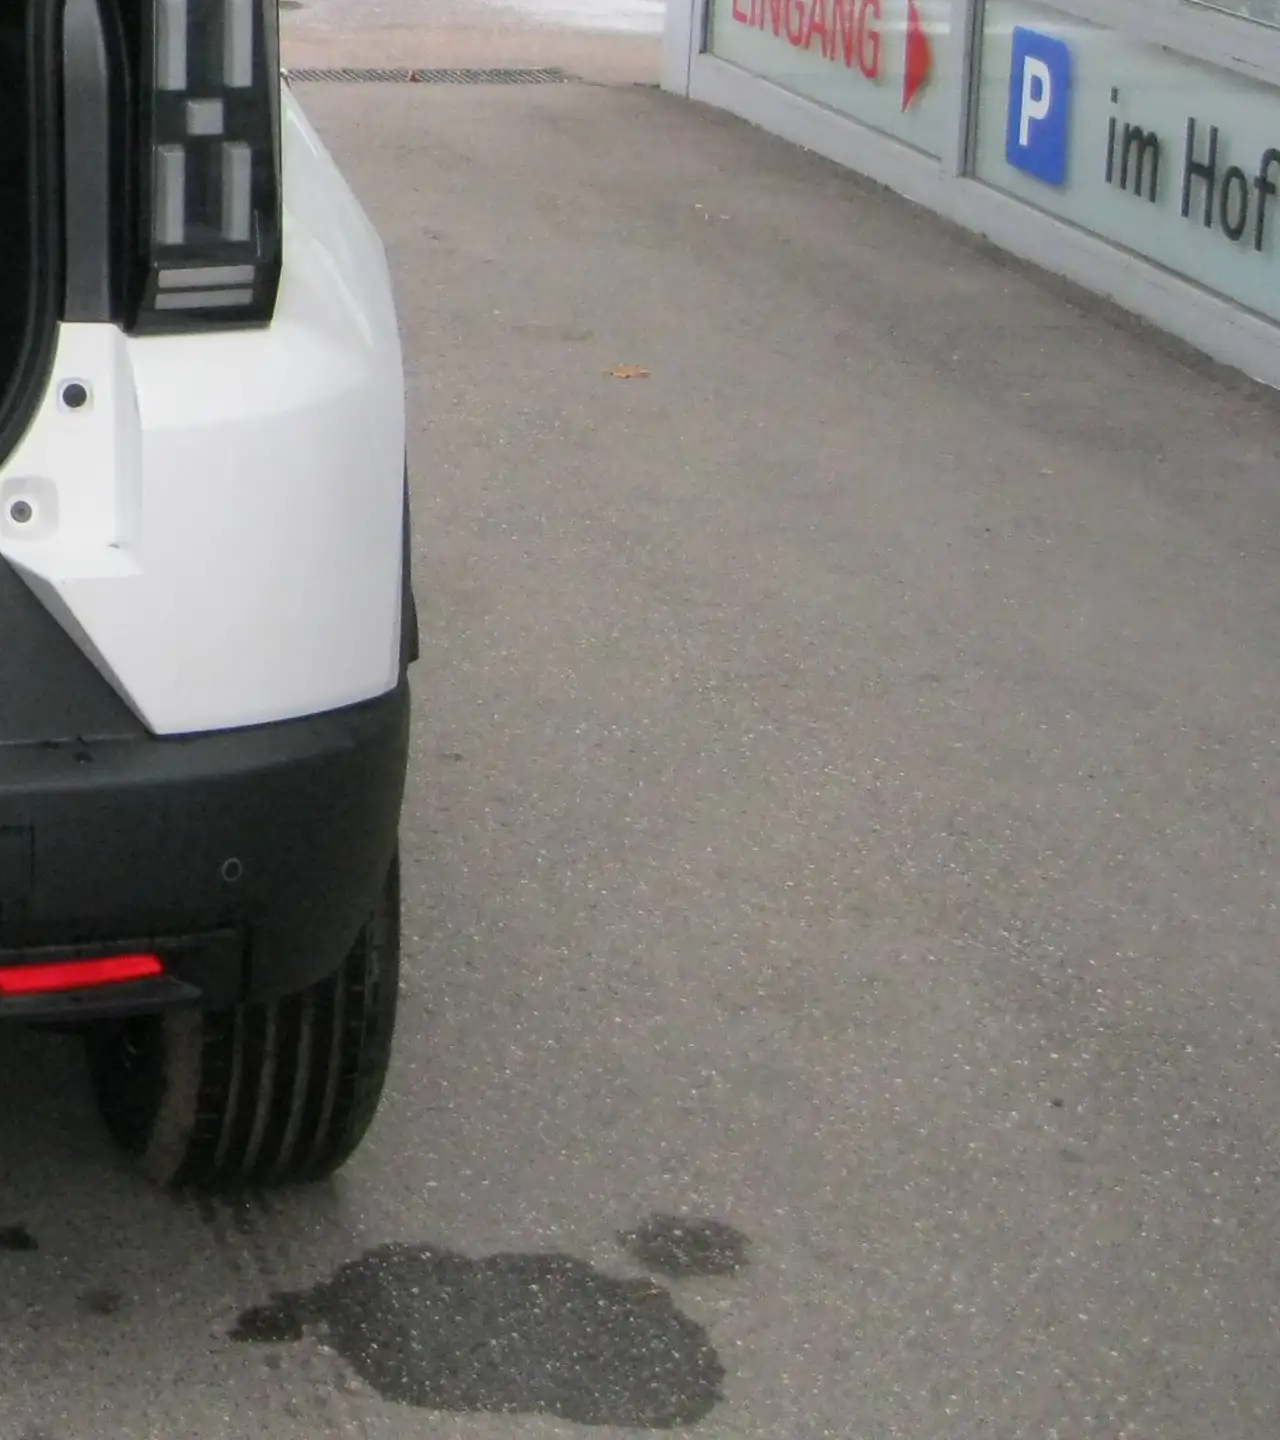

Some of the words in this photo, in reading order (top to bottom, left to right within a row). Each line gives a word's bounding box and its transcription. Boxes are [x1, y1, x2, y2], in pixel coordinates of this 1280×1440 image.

[1018, 55, 1052, 146] P
[1105, 86, 1160, 203] im
[1181, 116, 1280, 252] Hof
